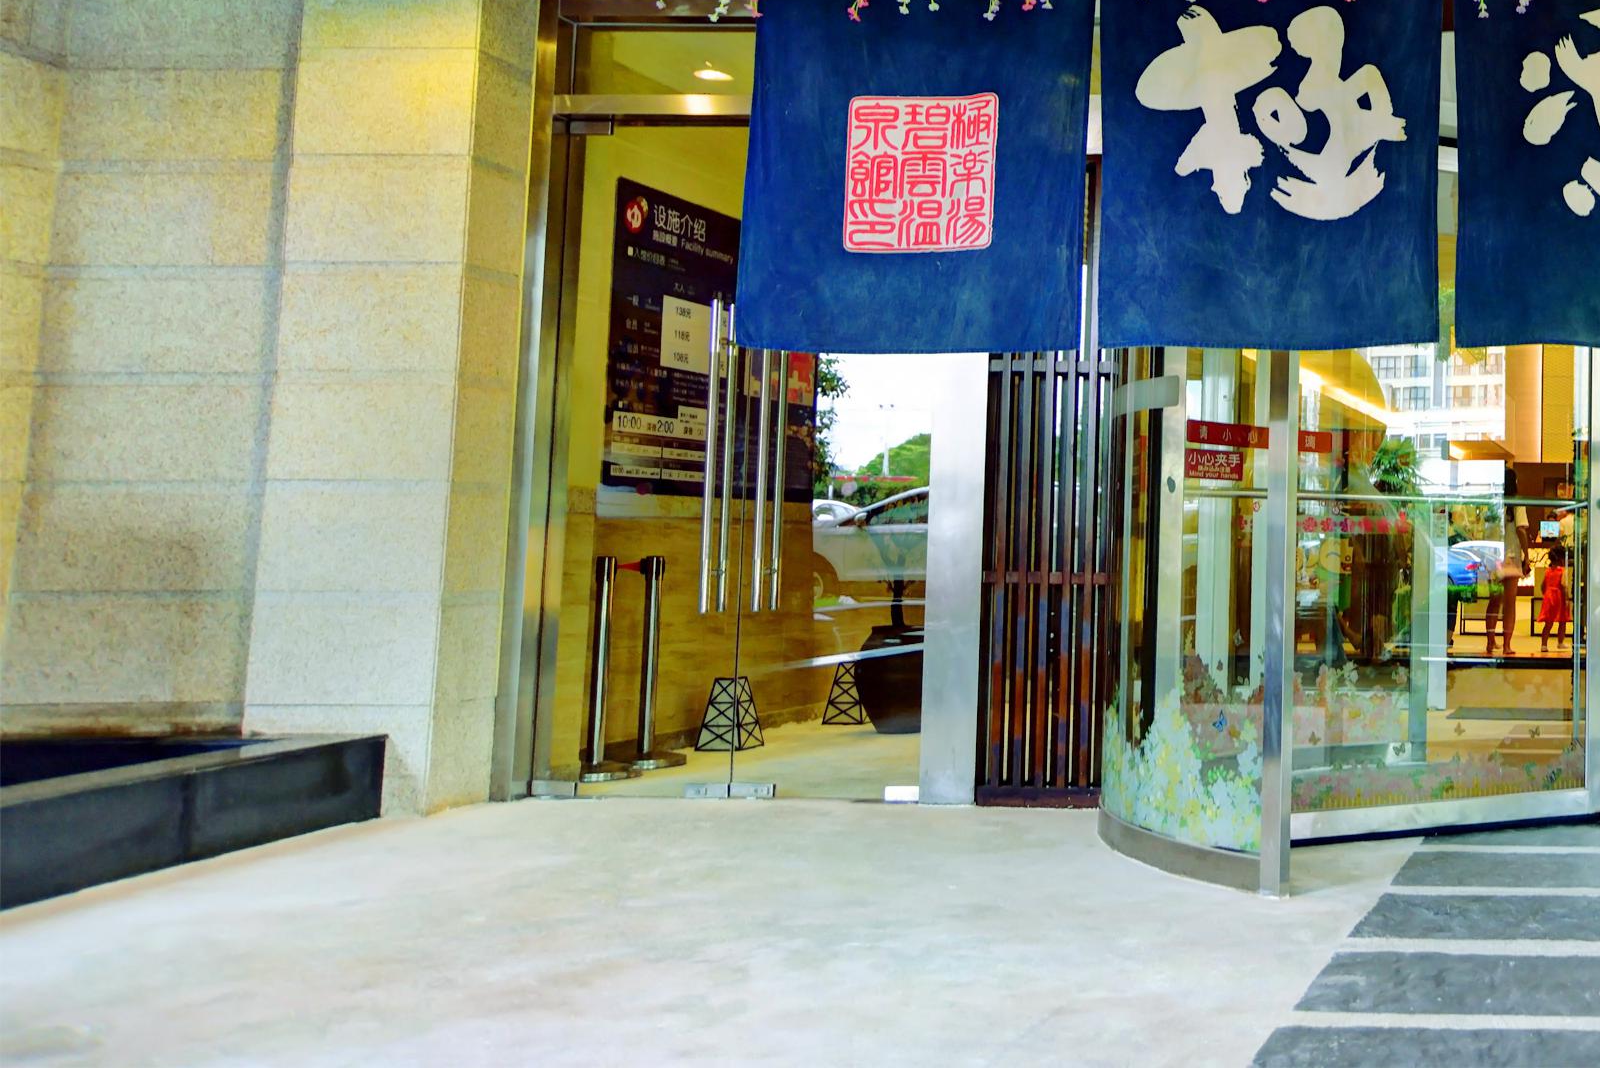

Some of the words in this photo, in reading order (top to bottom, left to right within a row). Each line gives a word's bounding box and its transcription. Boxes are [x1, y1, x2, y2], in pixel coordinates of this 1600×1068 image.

[653, 204, 706, 242] 设施介绍
[681, 238, 705, 256] Facility
[705, 244, 734, 265] summary
[675, 306, 692, 319] 138元
[617, 414, 642, 430] 10:00
[1188, 452, 1241, 467] 小心夹手
[1189, 470, 1204, 478] Mind
[1205, 472, 1219, 480] your
[1220, 473, 1239, 481] hands
